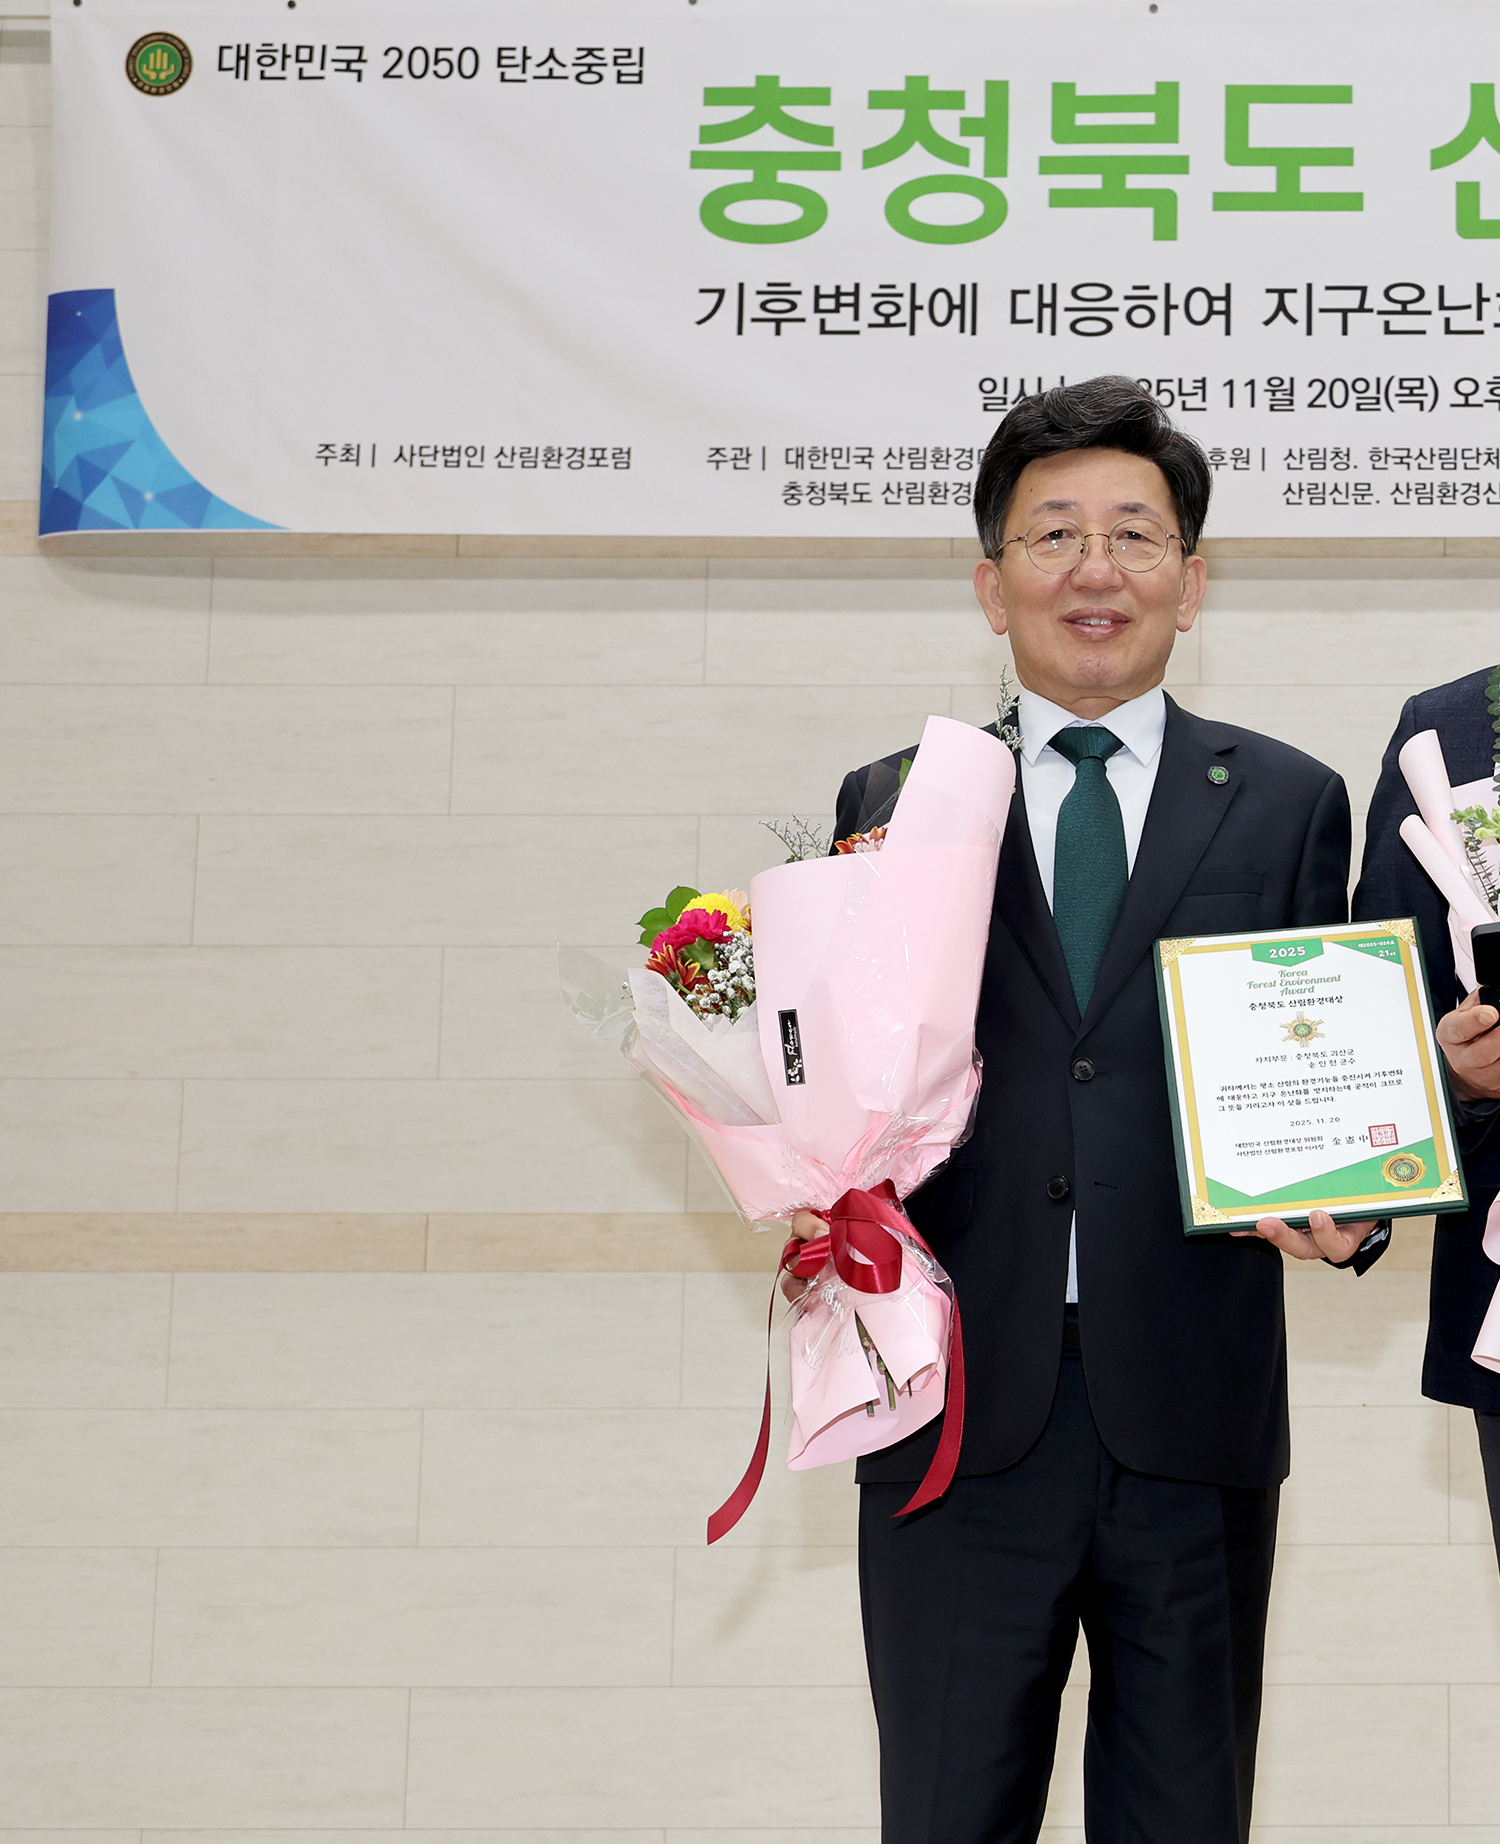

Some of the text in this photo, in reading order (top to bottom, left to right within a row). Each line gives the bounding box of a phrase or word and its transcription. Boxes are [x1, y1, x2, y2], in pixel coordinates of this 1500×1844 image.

[217, 43, 369, 83] 대한민국
[382, 45, 480, 80] 2050
[496, 45, 645, 85] 탄소중립
[690, 75, 1363, 244] 충청북도
[694, 281, 978, 337] 기후변화에
[1010, 282, 1232, 338] 대응하여
[1222, 376, 1295, 413] 11월
[1307, 375, 1440, 413] 20일(목)
[315, 443, 631, 470] 주최 사단법인 산림환경포럼
[706, 446, 752, 471] 주관
[785, 446, 875, 471] 대한민국
[1209, 447, 1250, 471] 후원
[1283, 446, 1358, 472] 산림청.
[781, 481, 972, 506] 충청북도 산림환경
[1282, 481, 1380, 506] 산림신문.
[1268, 946, 1307, 959] 2025
[1378, 949, 1397, 957] 21st
[1246, 974, 1342, 990] Forest Environment
[1277, 969, 1308, 978] Korea
[1248, 995, 1344, 1011] 충청북도 산림환경대상
[1279, 985, 1316, 997] Award
[1295, 1051, 1328, 1061] 충청북도
